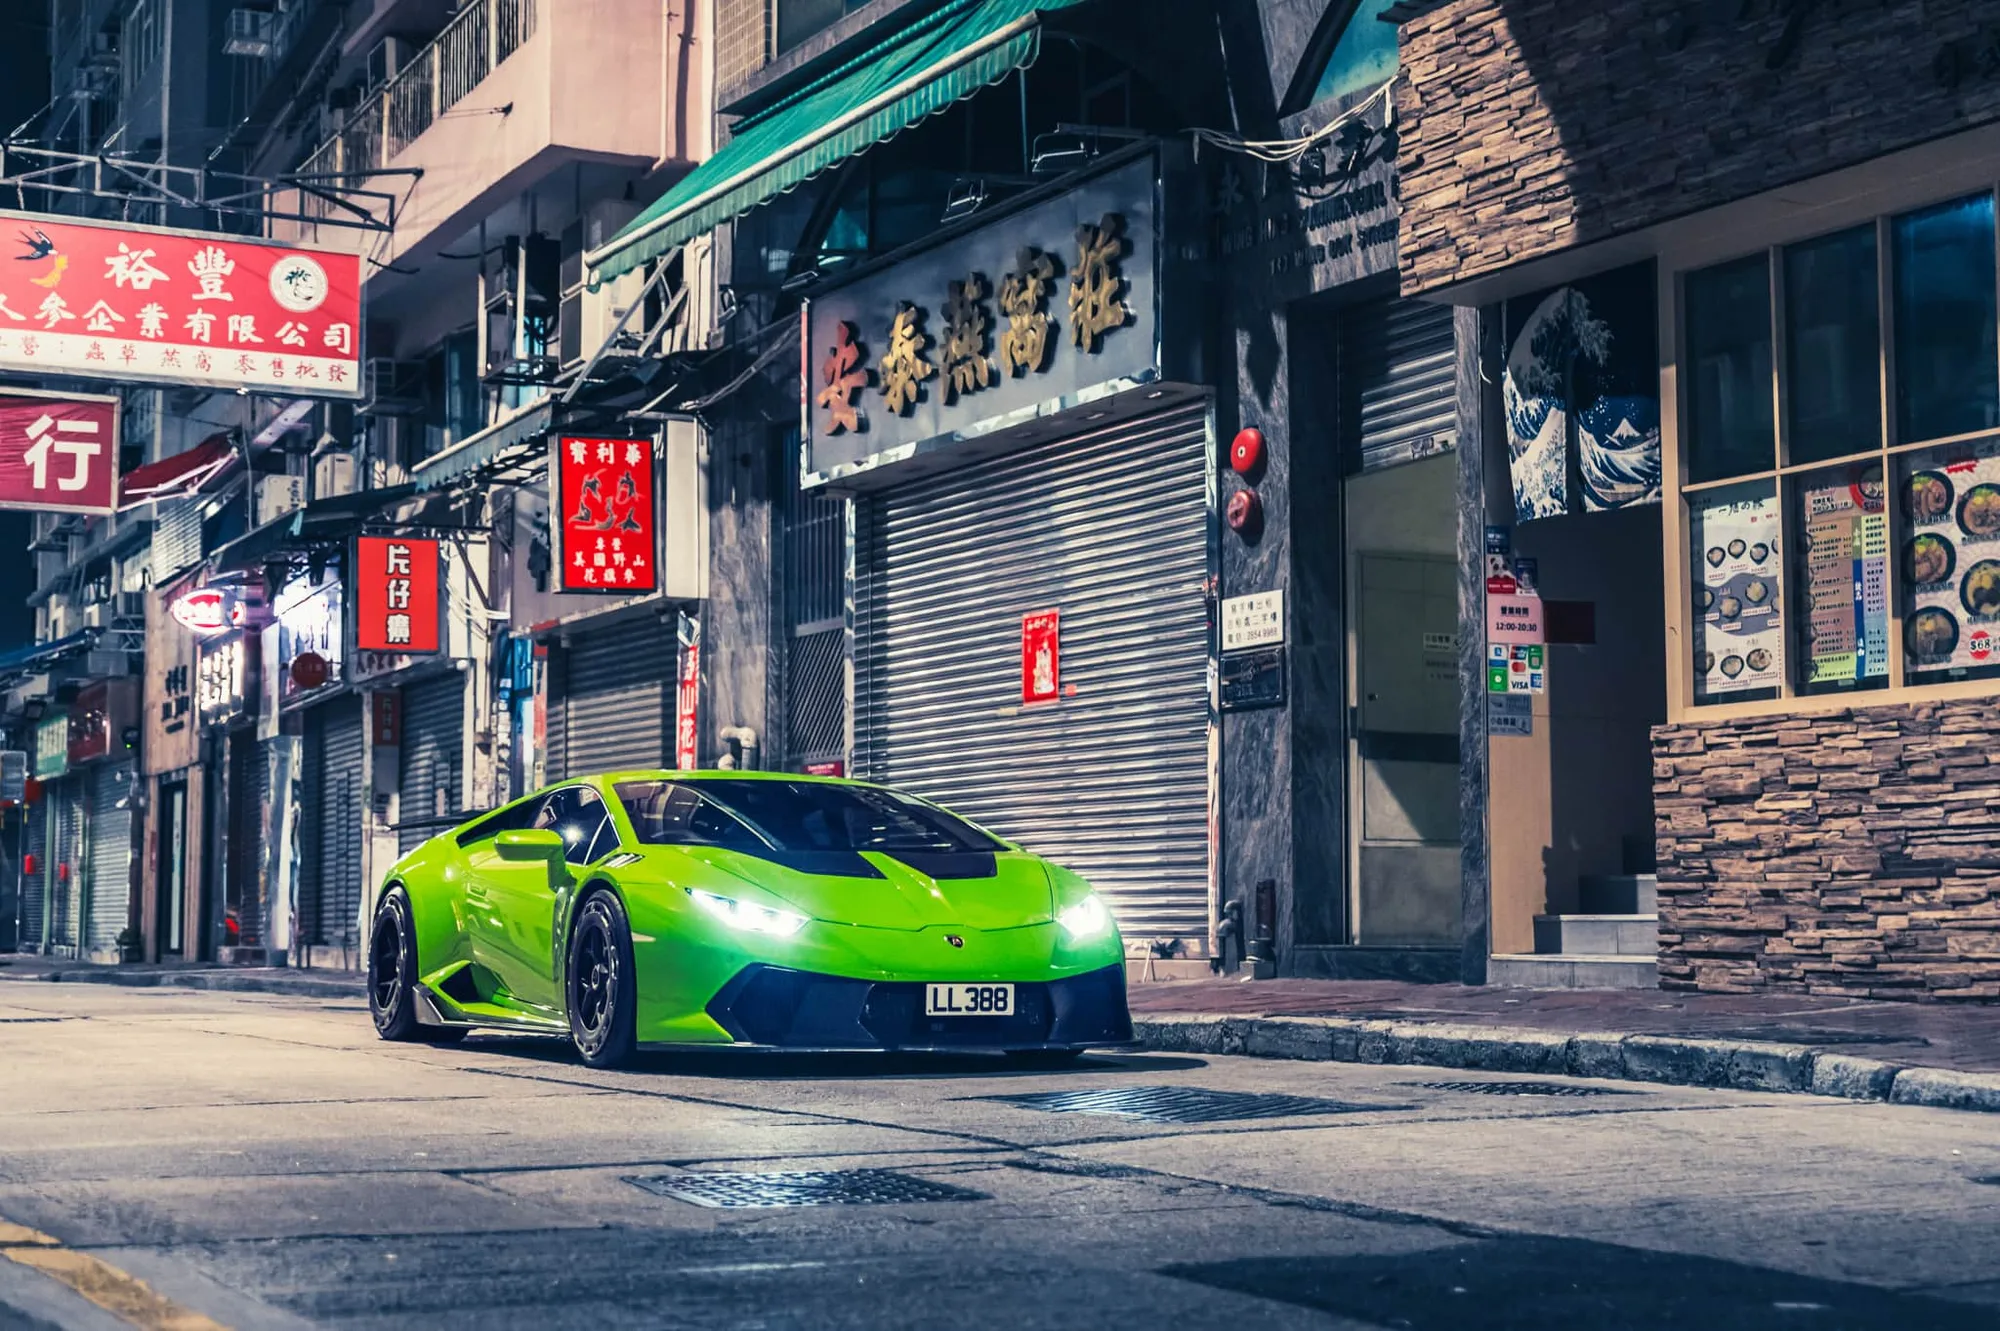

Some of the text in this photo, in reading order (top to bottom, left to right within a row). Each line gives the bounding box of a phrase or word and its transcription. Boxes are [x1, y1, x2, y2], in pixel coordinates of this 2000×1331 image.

[104, 242, 236, 302] 裕豐
[23, 413, 102, 492] 行
[1496, 621, 1537, 632] 12:00-20:30
[1511, 680, 1529, 690] VISA
[932, 986, 1008, 1012] LL 388
